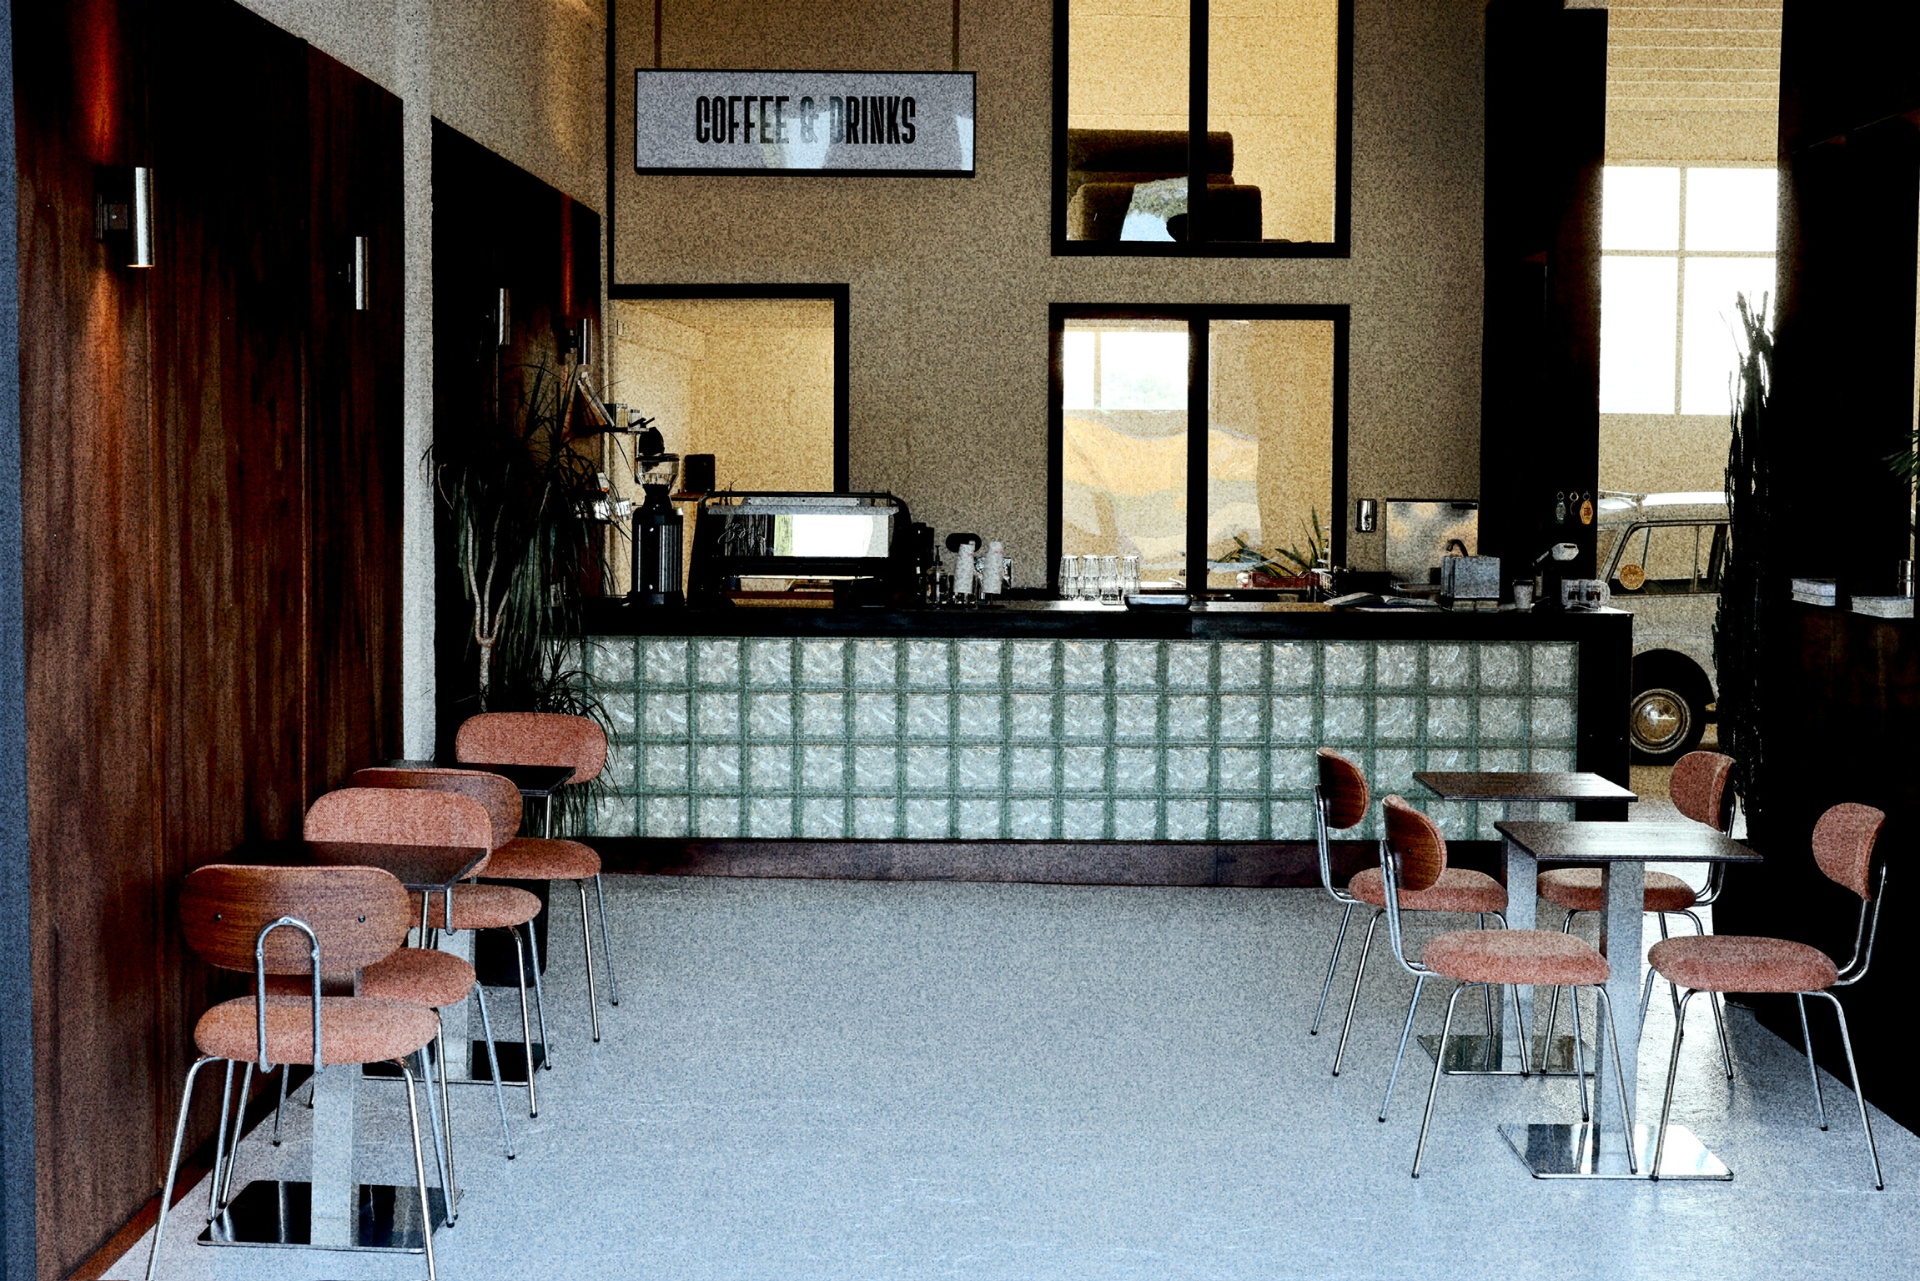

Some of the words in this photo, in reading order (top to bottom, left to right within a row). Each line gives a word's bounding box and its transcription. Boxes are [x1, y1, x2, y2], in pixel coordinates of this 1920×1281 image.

[696, 95, 790, 143] COFFEE
[800, 96, 819, 144] &
[830, 96, 916, 144] DRINKS
